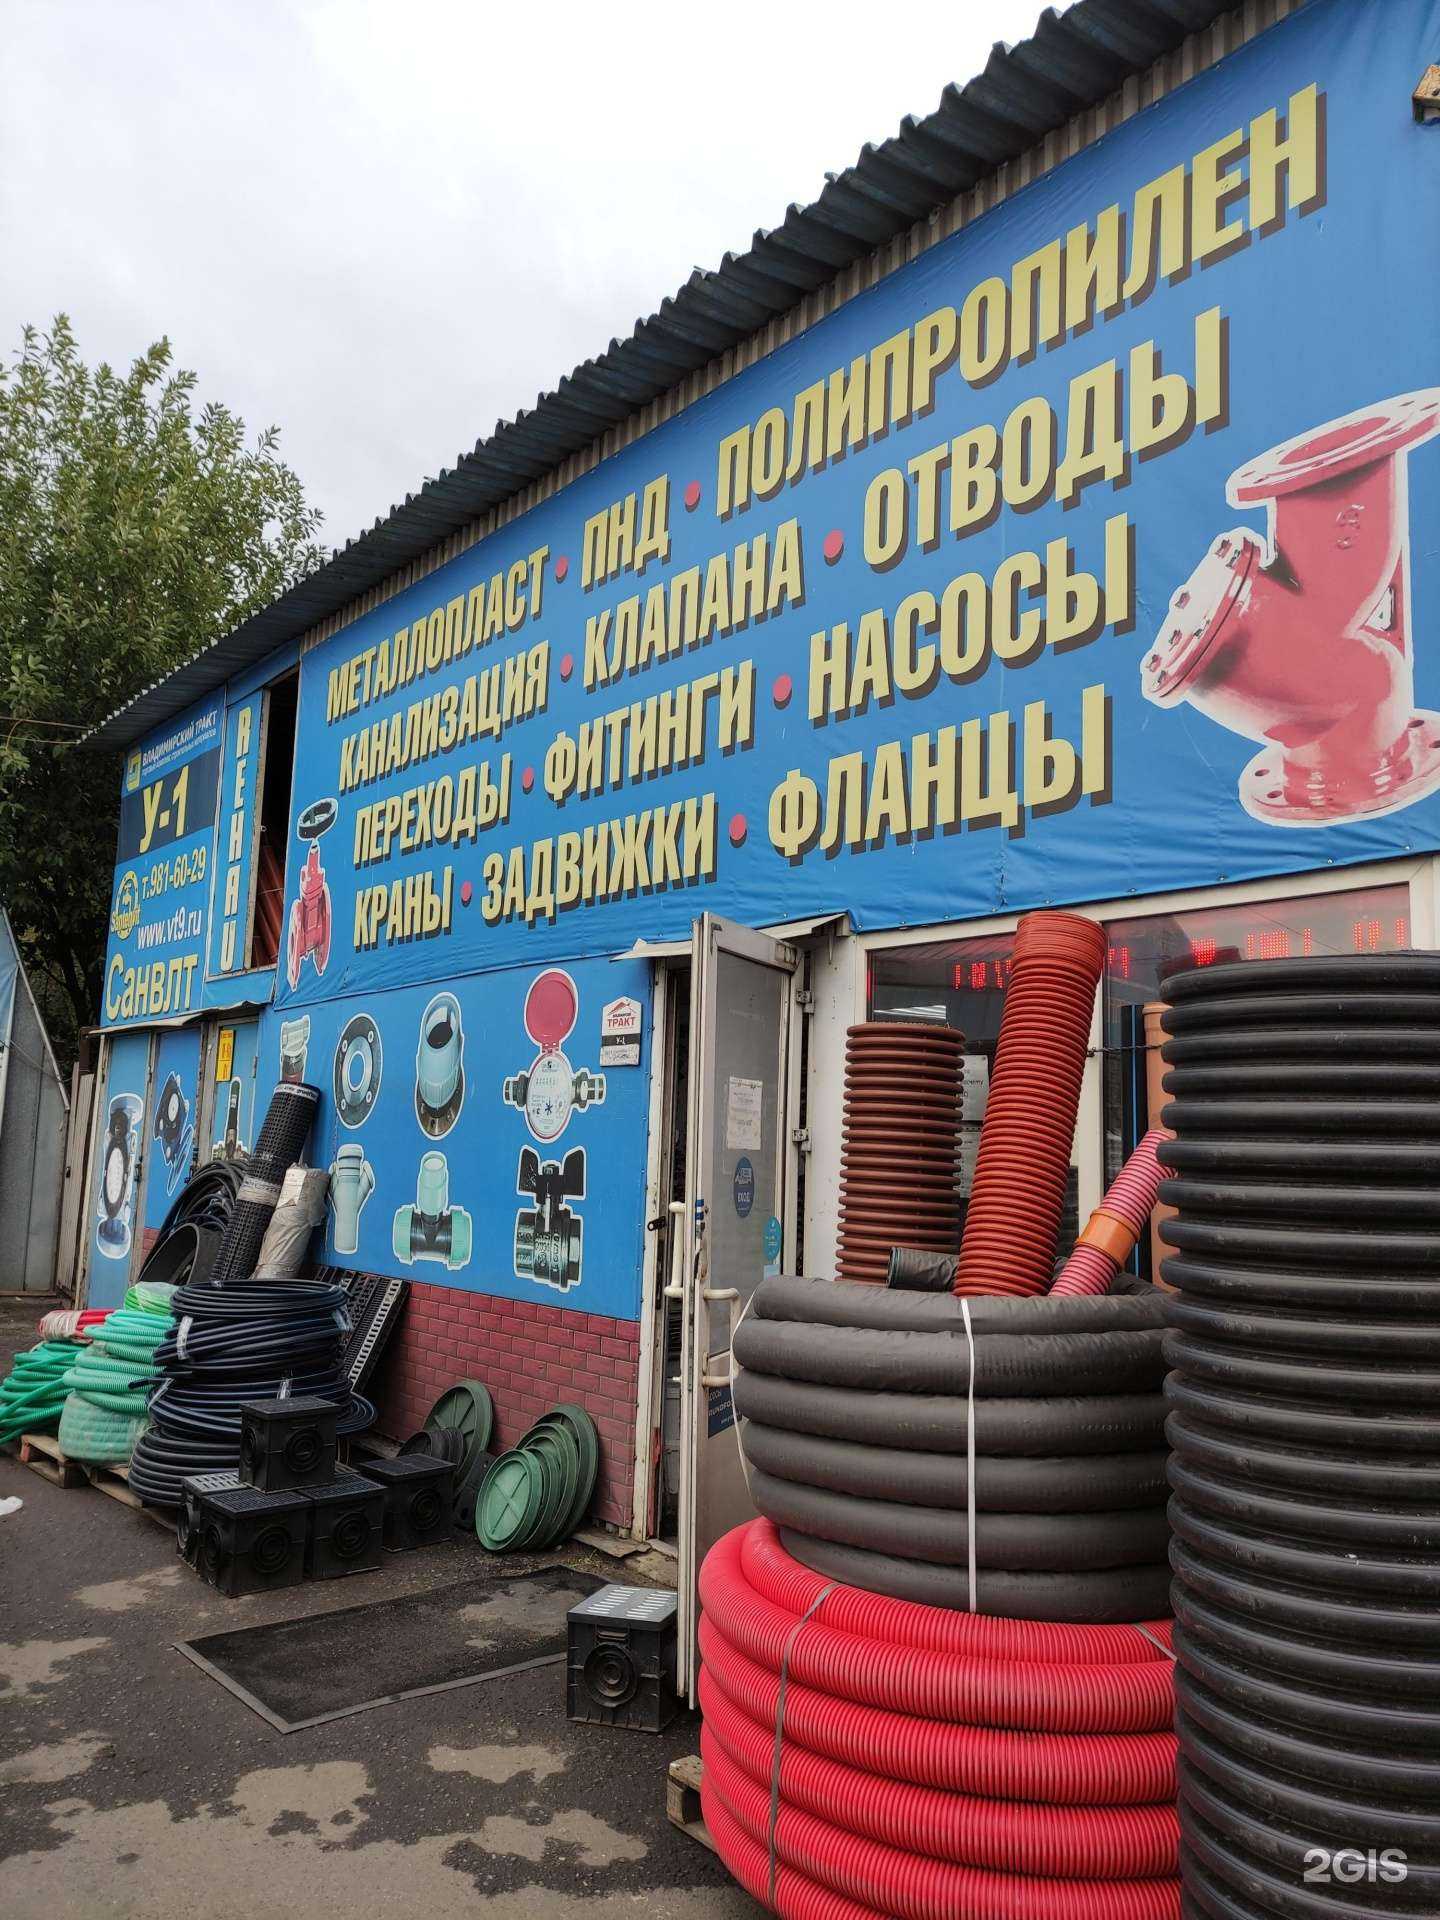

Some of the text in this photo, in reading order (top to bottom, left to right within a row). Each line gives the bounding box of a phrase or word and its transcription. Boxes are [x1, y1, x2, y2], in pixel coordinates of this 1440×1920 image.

[327, 83, 1318, 722] МЕТАЛЛОПЛАСТ ПНД ПОЛИПРОПИЛЕН
[339, 306, 1222, 791] КАНАЛИЗАЦИЯ КЛАПАНА ОТВОДЫ
[139, 765, 188, 853] У-1
[354, 513, 1129, 864] ПЕРЕХОДЫ ФИТИНГИ НАСОСЫ
[354, 683, 1106, 949] КРАНЫ ЗАДВИЖКИ ФЛАНЦЫ
[138, 906, 202, 950] www.vt9.ru
[220, 707, 252, 972] REHAU
[607, 1016, 636, 1028] ТРАКТ
